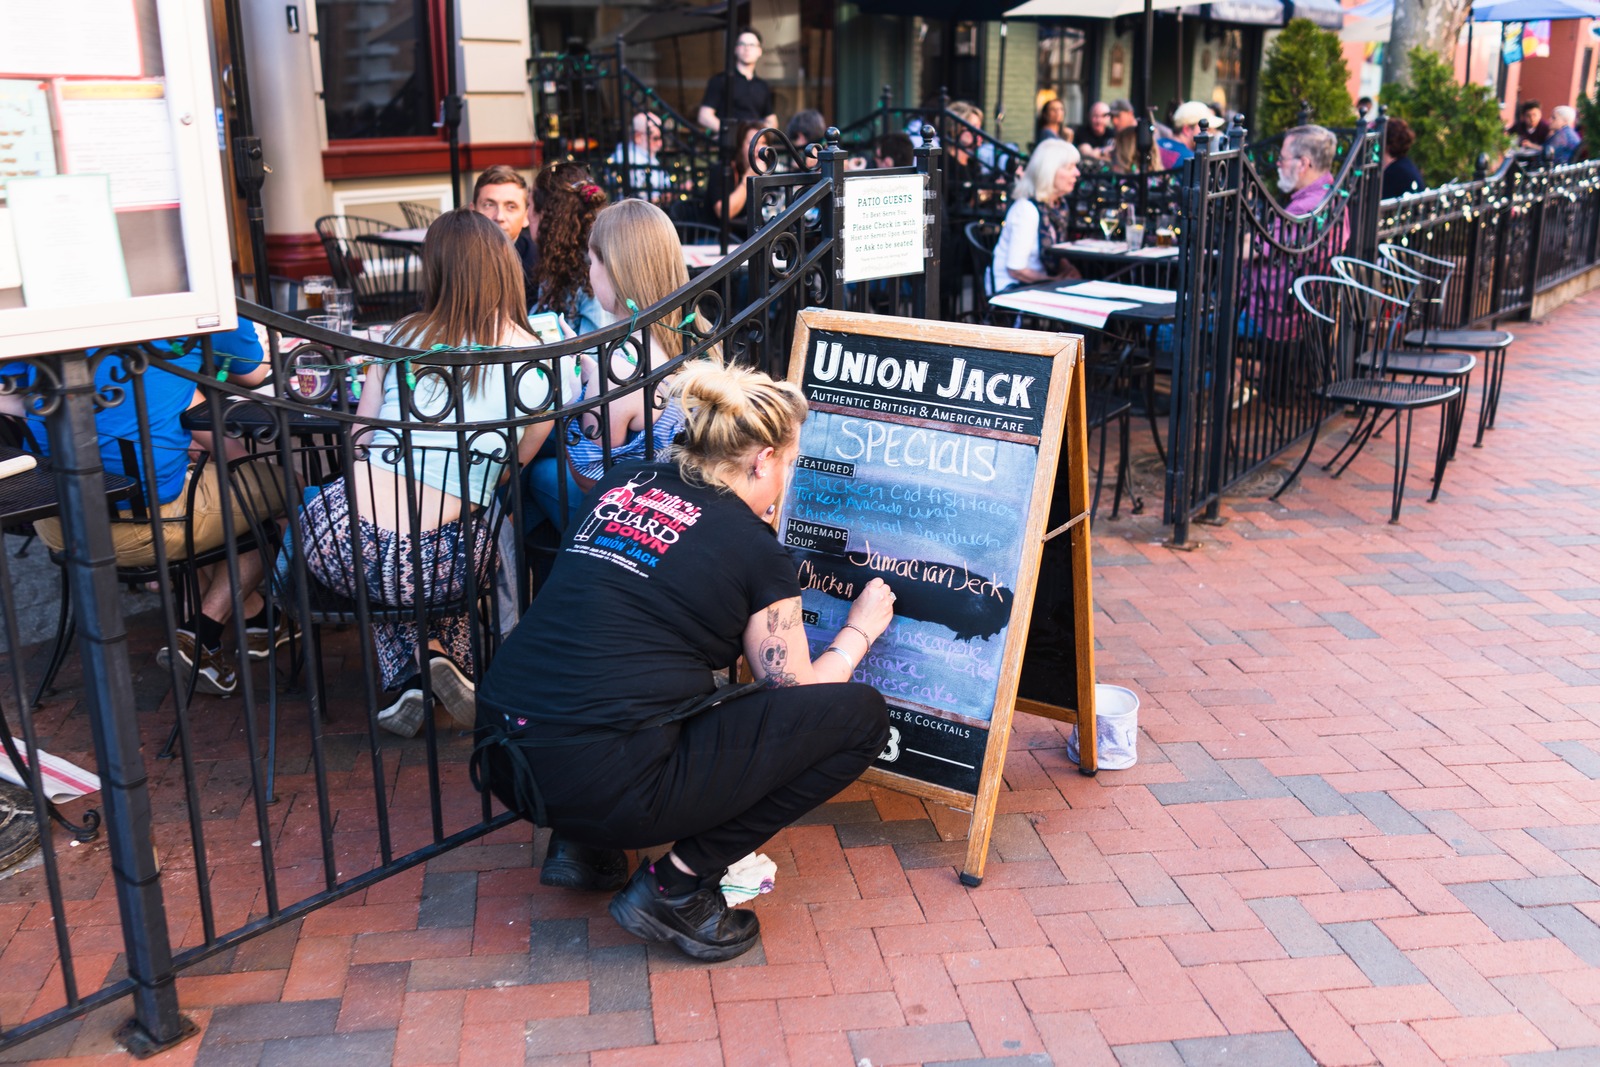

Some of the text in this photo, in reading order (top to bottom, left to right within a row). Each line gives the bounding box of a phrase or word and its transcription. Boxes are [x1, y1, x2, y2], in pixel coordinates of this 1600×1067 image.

[857, 194, 913, 207] PATIO GUESTS
[852, 223, 872, 231] Please
[874, 220, 893, 229] Check
[902, 218, 916, 226] with
[864, 243, 875, 251] Ask
[894, 239, 913, 248] seated
[812, 340, 1036, 409] UNION JACK
[810, 389, 1025, 433] AUTHENTIC BRITISH & AMERICAN FARE
[797, 456, 854, 476] FEATURED:
[594, 501, 680, 544] GUARD
[652, 511, 687, 533] Your
[787, 519, 848, 541] HOMEMADE
[594, 535, 627, 551] UNION
[626, 547, 660, 567] JACK
[604, 521, 670, 554] DOWN
[786, 533, 817, 549] SOUP:
[797, 559, 854, 599] Chicken
[954, 560, 1004, 603] Jerk
[903, 712, 913, 723] &
[915, 714, 970, 739] COCKTAILS
